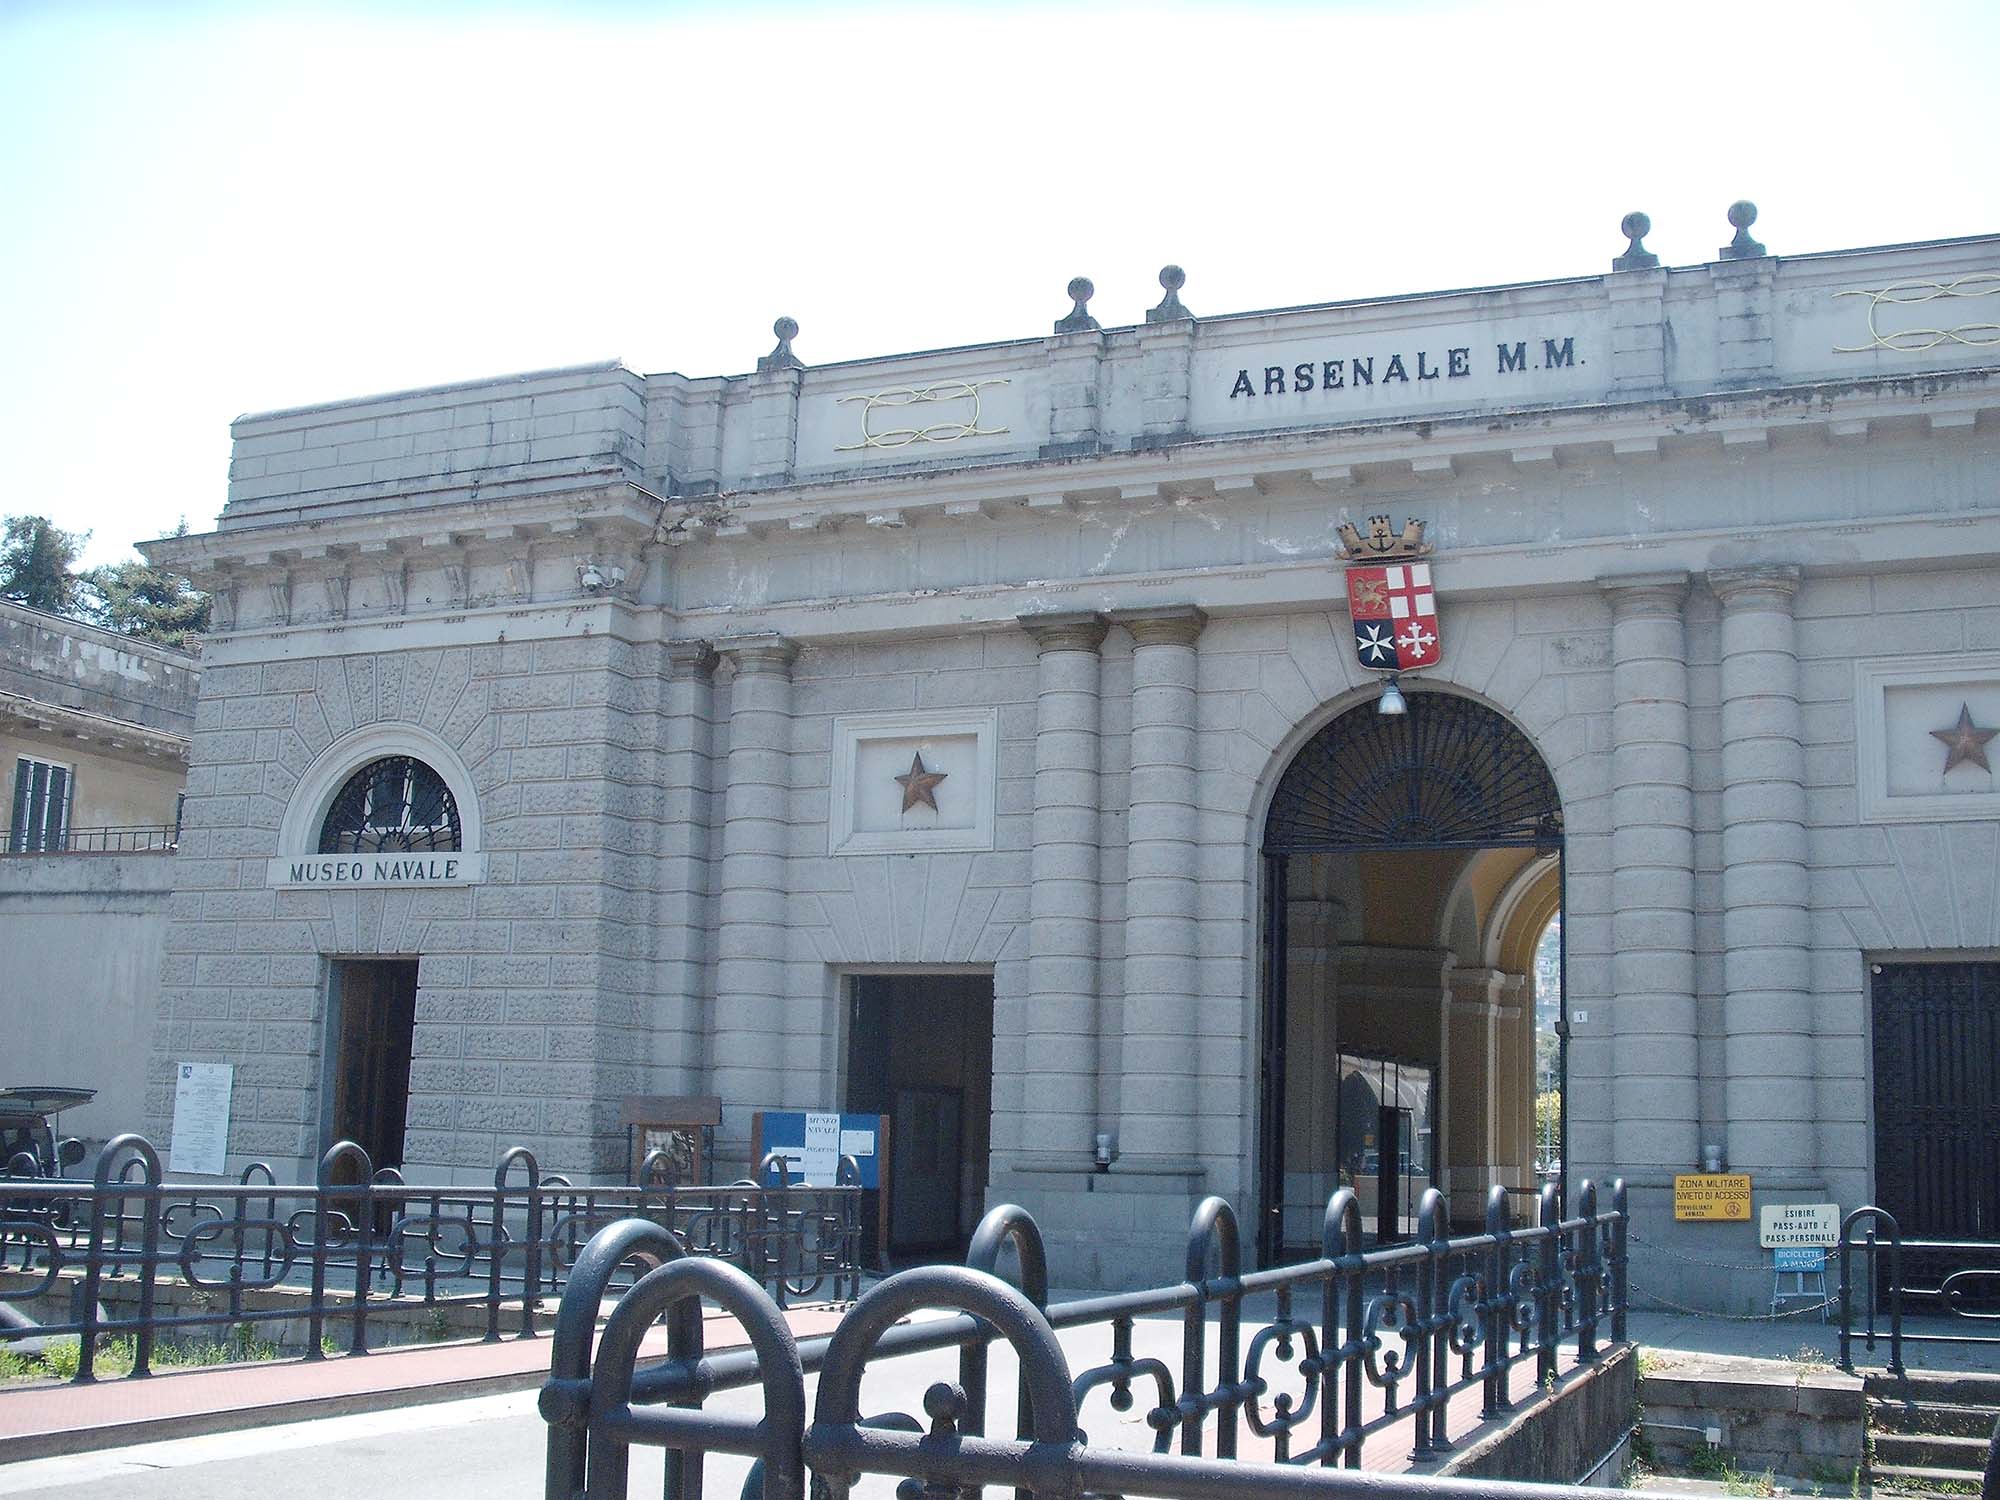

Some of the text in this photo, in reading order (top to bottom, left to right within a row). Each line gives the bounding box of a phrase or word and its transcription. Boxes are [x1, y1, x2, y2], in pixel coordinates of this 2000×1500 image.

[1230, 337, 1586, 398] ARSENALE M.M.
[289, 860, 459, 882] MUSEO NAVALE
[1680, 1179, 1746, 1188] ZONA MILITARE
[1677, 1191, 1750, 1200] DIVIETO DI ACCESSO
[1785, 1209, 1816, 1218] ESIBIRE
[1773, 1221, 1829, 1230] PASS-AUTO E
[1766, 1233, 1836, 1242] PASS-PERSONALE
[1778, 1250, 1821, 1258] BICICLETTE
